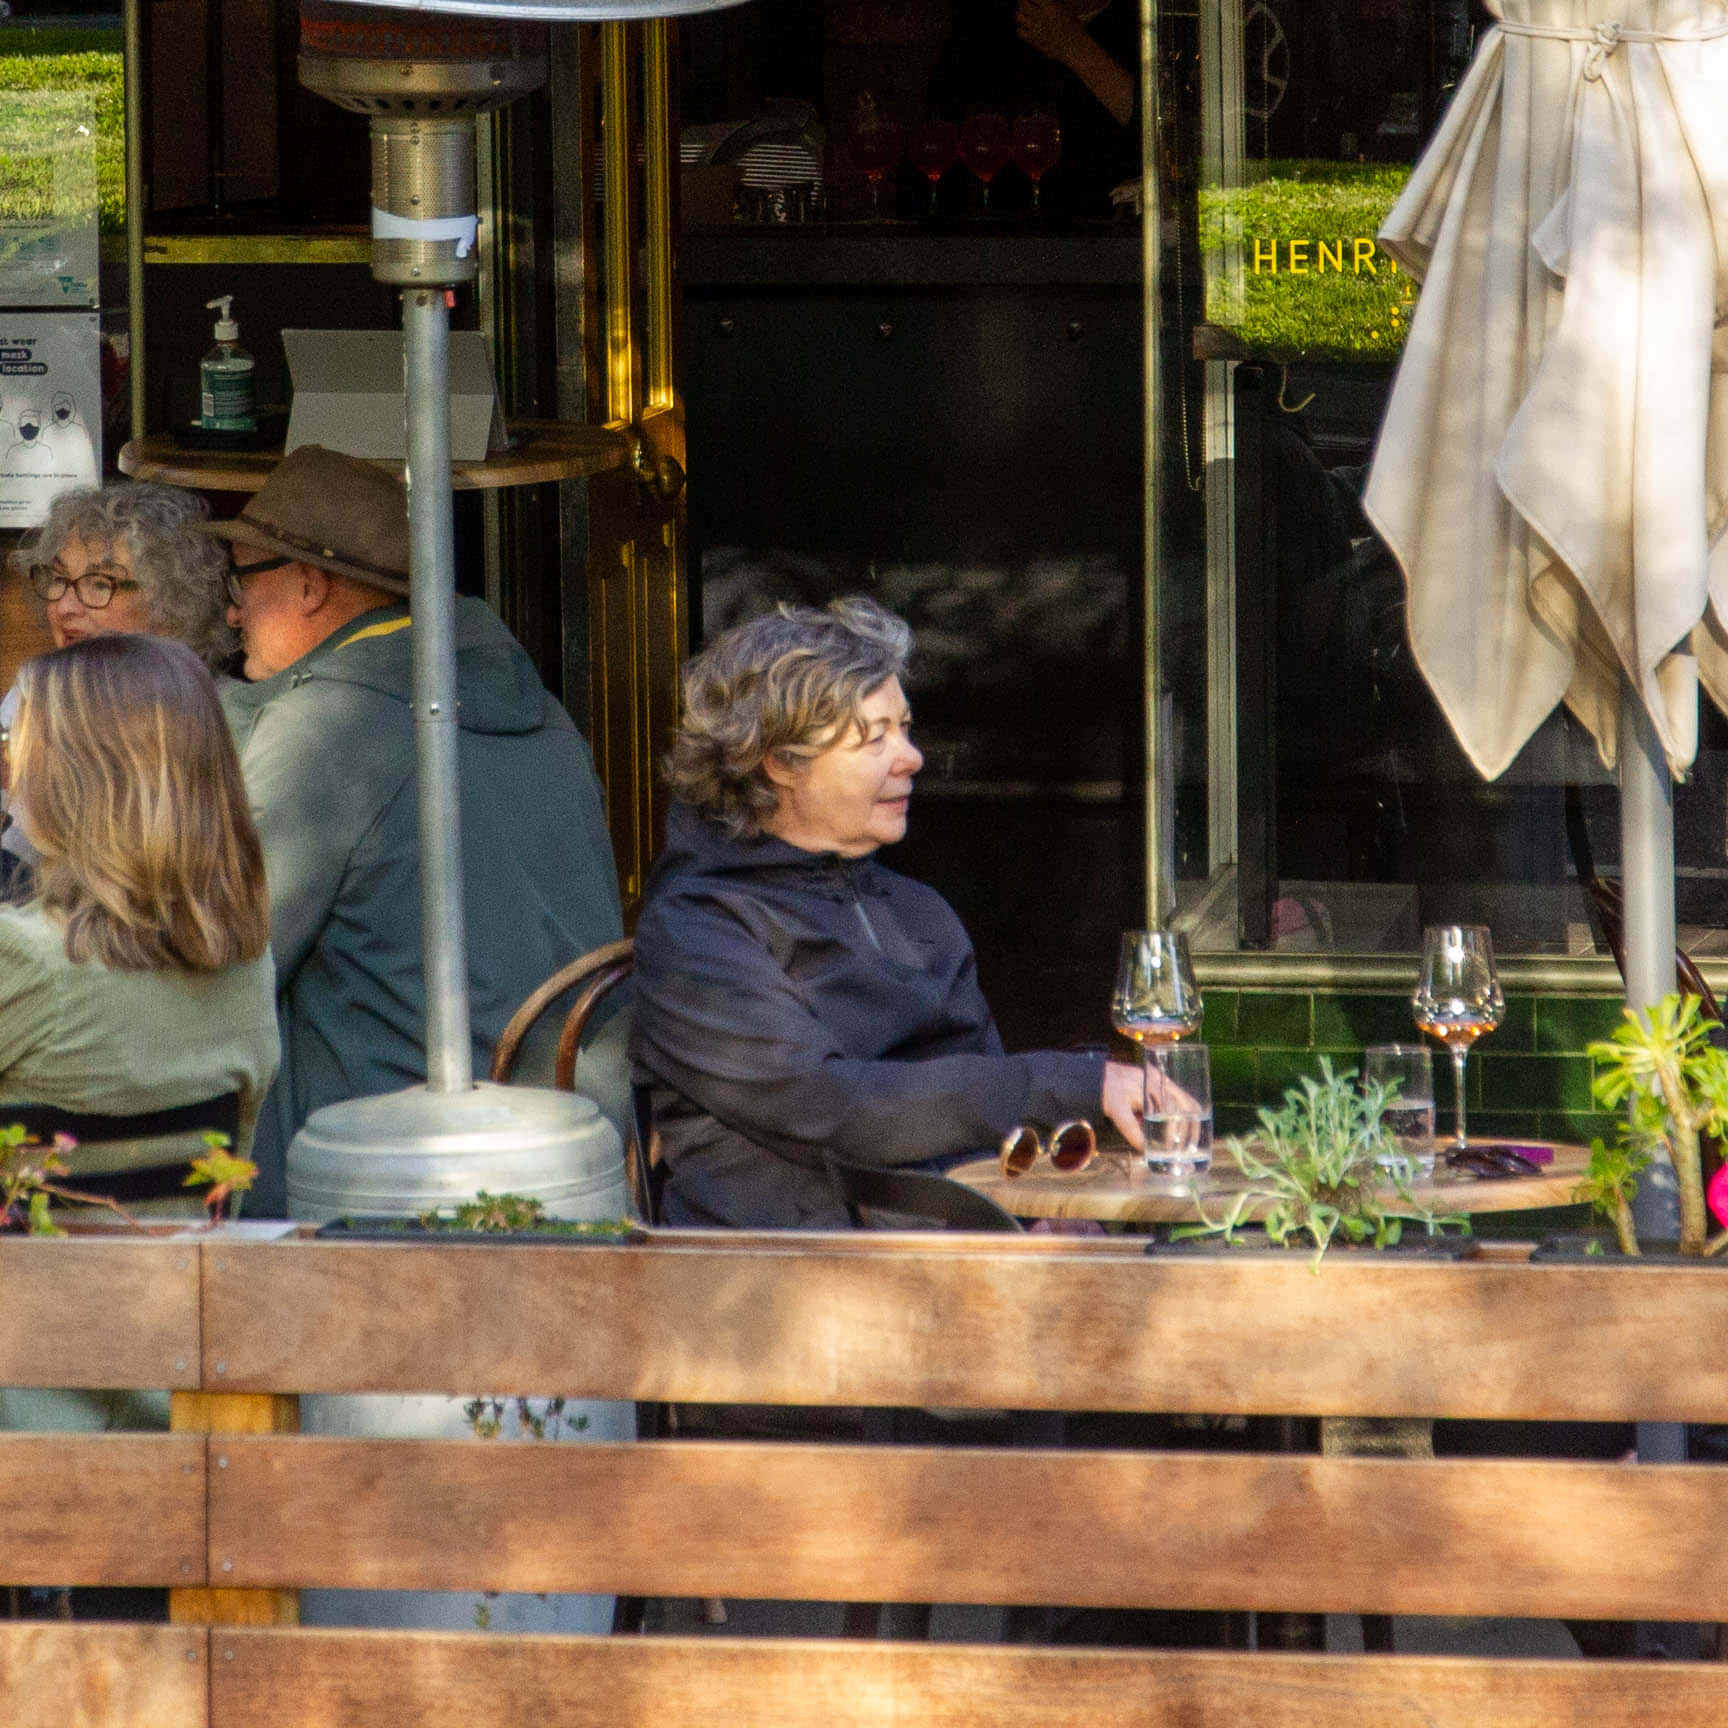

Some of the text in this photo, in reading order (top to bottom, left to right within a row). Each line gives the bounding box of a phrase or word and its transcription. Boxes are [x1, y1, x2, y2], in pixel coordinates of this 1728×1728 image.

[1253, 238, 1398, 275] HENR
[1, 350, 28, 359] mask
[2, 363, 45, 373] location
